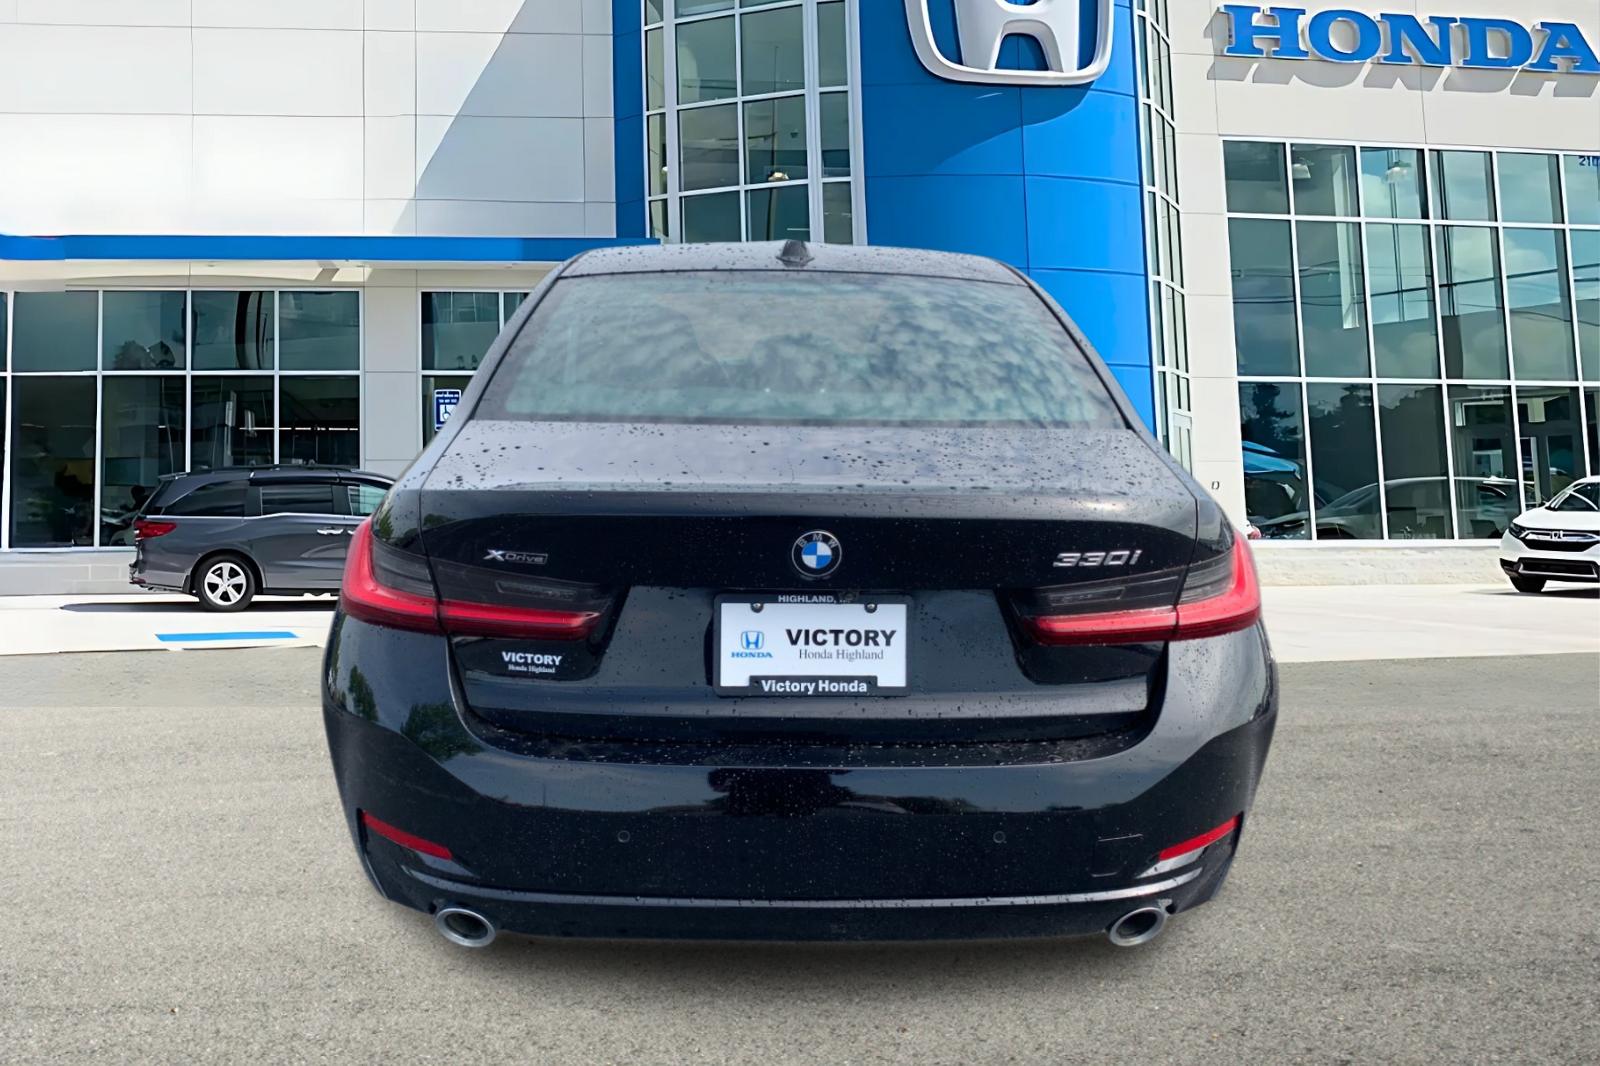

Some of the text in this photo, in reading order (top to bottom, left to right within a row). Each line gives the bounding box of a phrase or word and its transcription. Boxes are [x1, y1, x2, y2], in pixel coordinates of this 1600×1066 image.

[1222, 4, 1600, 74] HONDA
[1052, 549, 1143, 568] 330i
[785, 628, 897, 647] VICTORY
[501, 651, 562, 666] VICTORY
[730, 651, 773, 659] HONDA
[799, 648, 884, 663] Honda Highland
[528, 665, 556, 674] Highland
[761, 679, 868, 695] Victory Honda
